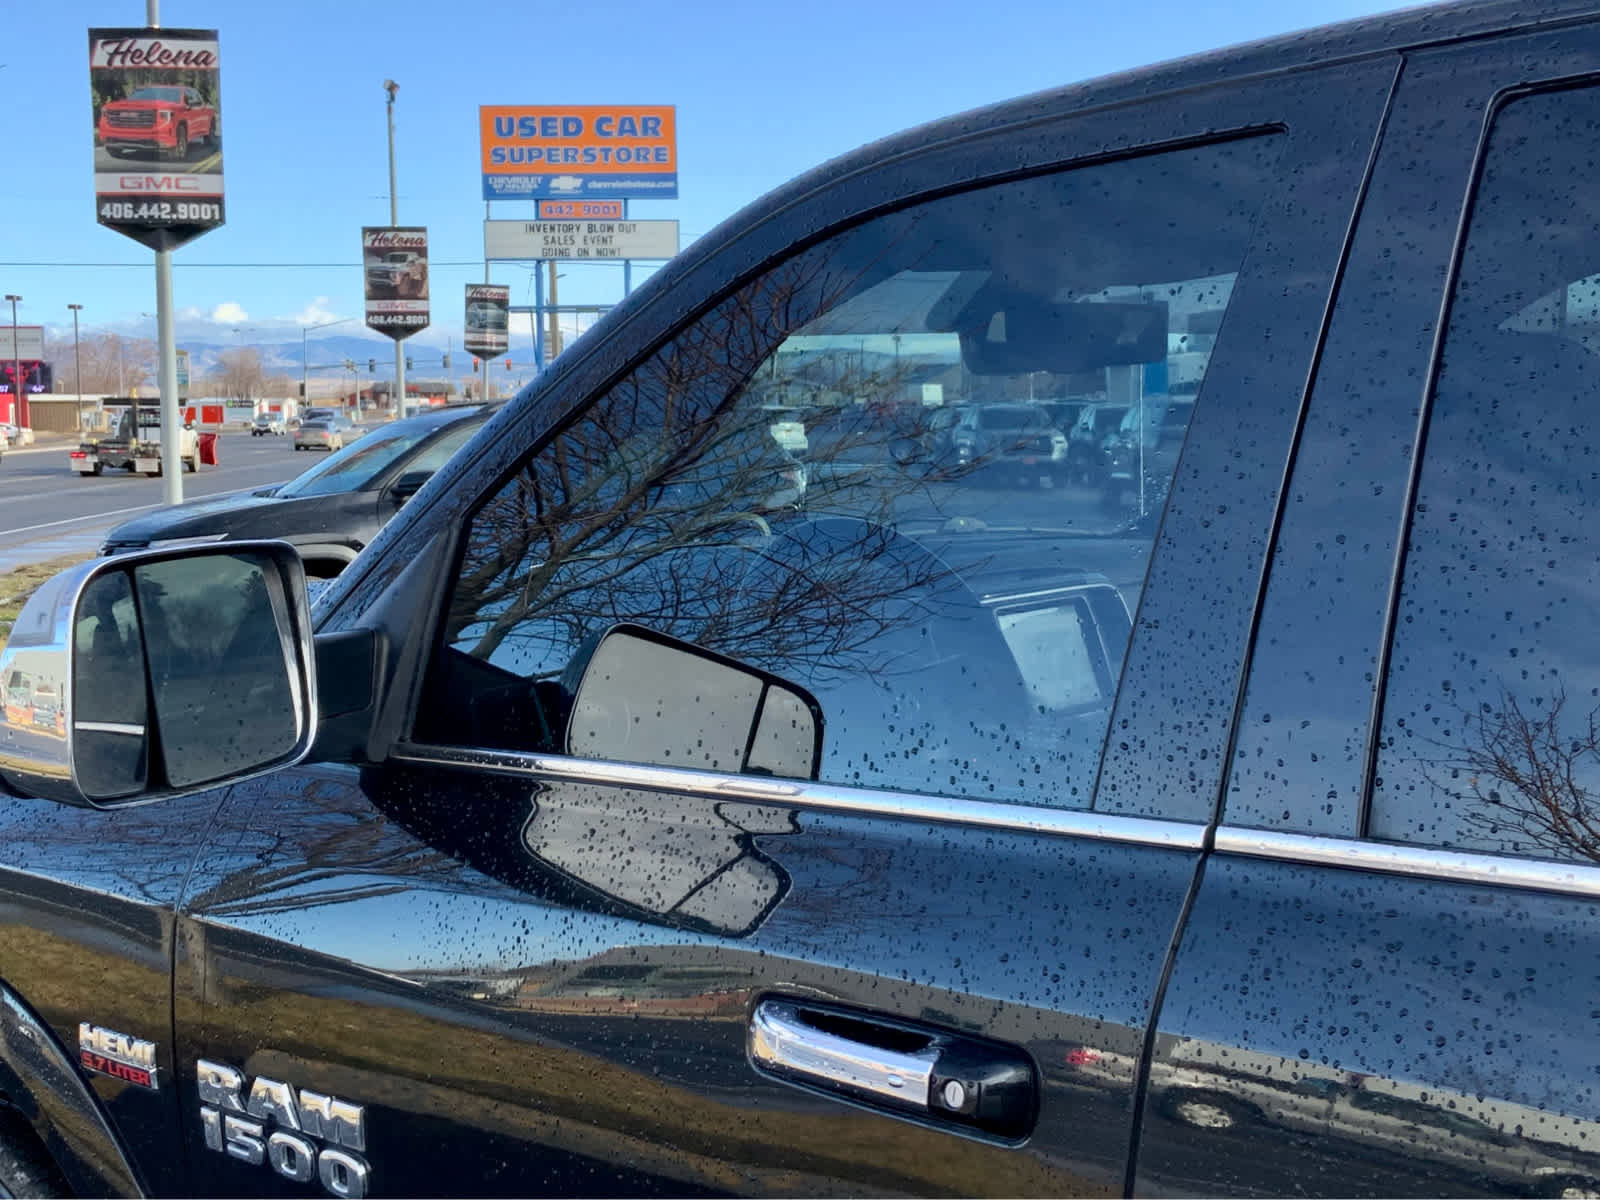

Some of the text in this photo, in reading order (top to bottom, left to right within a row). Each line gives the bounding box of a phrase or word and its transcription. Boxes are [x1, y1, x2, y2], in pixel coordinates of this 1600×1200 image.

[101, 38, 216, 67] Helena
[494, 115, 664, 138] USED CAR
[491, 146, 669, 164] SUPERSTORE
[120, 176, 199, 190] GMC
[100, 203, 220, 220] 406.442.9001
[525, 223, 637, 233] INVENTORY BLOW OUT
[367, 231, 425, 248] Helena
[543, 235, 614, 246] SALES EVENT
[542, 247, 621, 257] GOING ON NOW!
[79, 1022, 156, 1068] HEMI
[81, 1051, 151, 1088] 5.7 LITER
[197, 1059, 366, 1151] RAM
[200, 1106, 371, 1199] 1500
